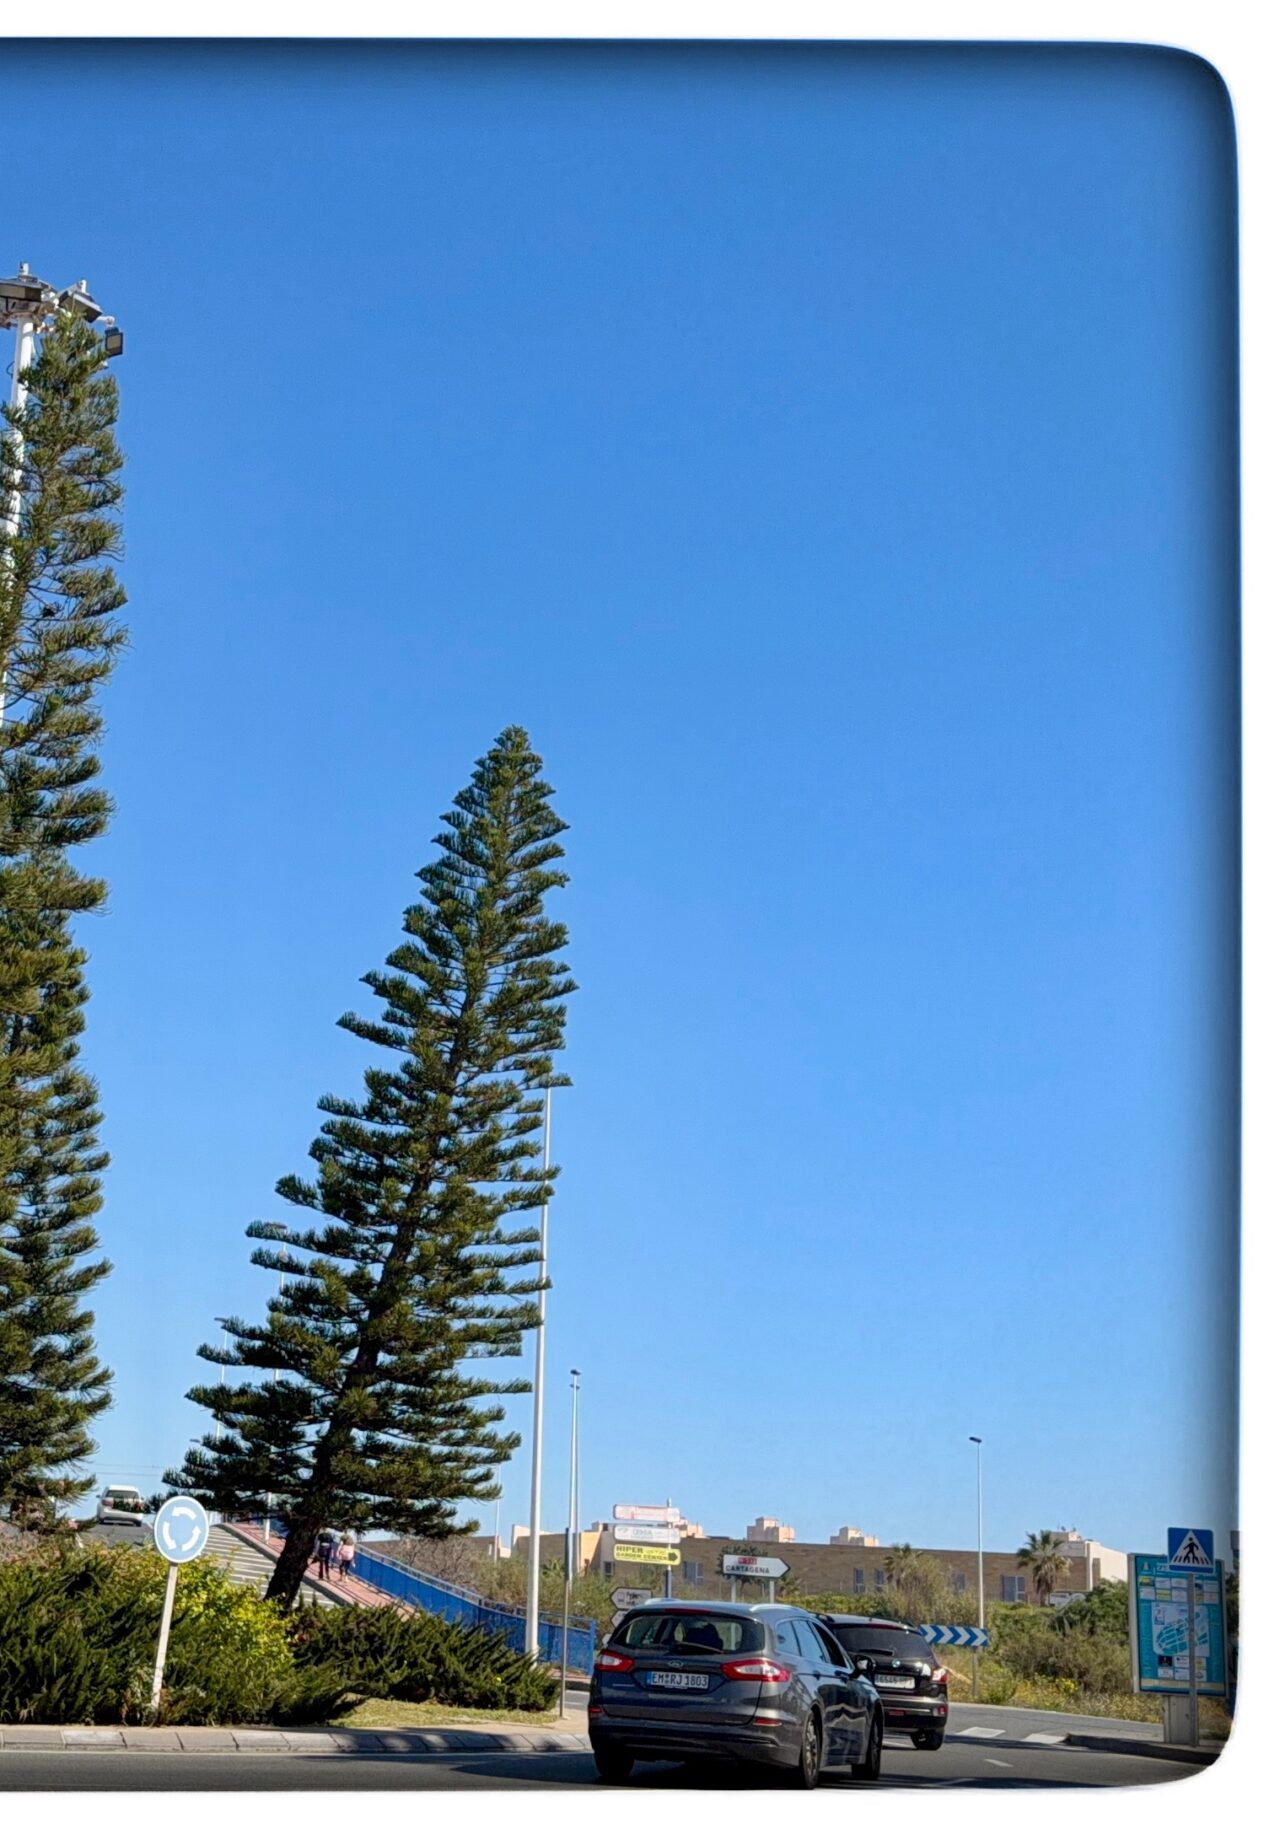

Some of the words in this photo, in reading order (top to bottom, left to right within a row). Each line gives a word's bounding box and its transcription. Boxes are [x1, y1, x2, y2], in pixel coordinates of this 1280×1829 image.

[616, 1545, 643, 1554] HIPER
[725, 1565, 770, 1574] CARTAGENA
[685, 1675, 708, 1687] 1803
